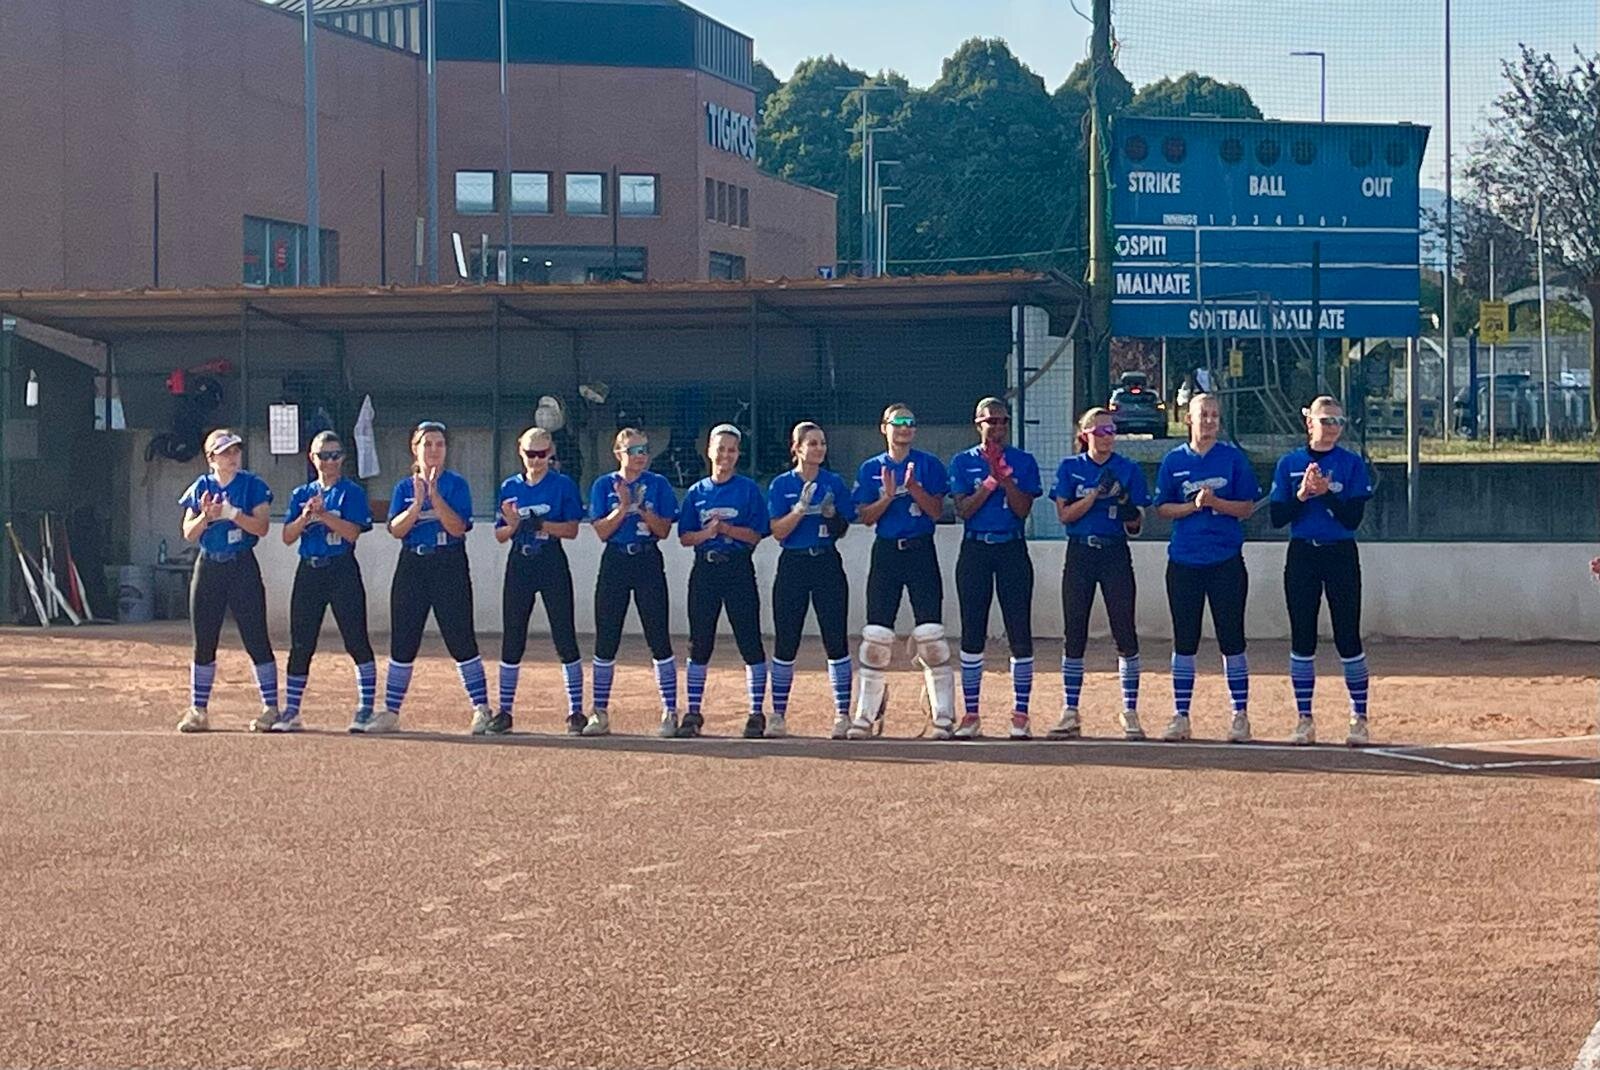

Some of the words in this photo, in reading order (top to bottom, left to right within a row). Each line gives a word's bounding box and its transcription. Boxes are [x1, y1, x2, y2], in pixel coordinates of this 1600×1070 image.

[706, 102, 757, 160] TIGROS
[1128, 171, 1181, 194] STRIKE
[1249, 175, 1286, 197] BALL
[1361, 177, 1393, 198] OUT
[1162, 214, 1198, 225] INNINGS
[1209, 214, 1214, 226] 1
[1231, 214, 1237, 226] 2
[1253, 214, 1259, 226] 3
[1275, 215, 1282, 226] 4
[1320, 215, 1326, 227] 6
[1342, 216, 1347, 227] 7
[1117, 235, 1167, 256] OSPITI
[1116, 273, 1191, 294] MALNATE
